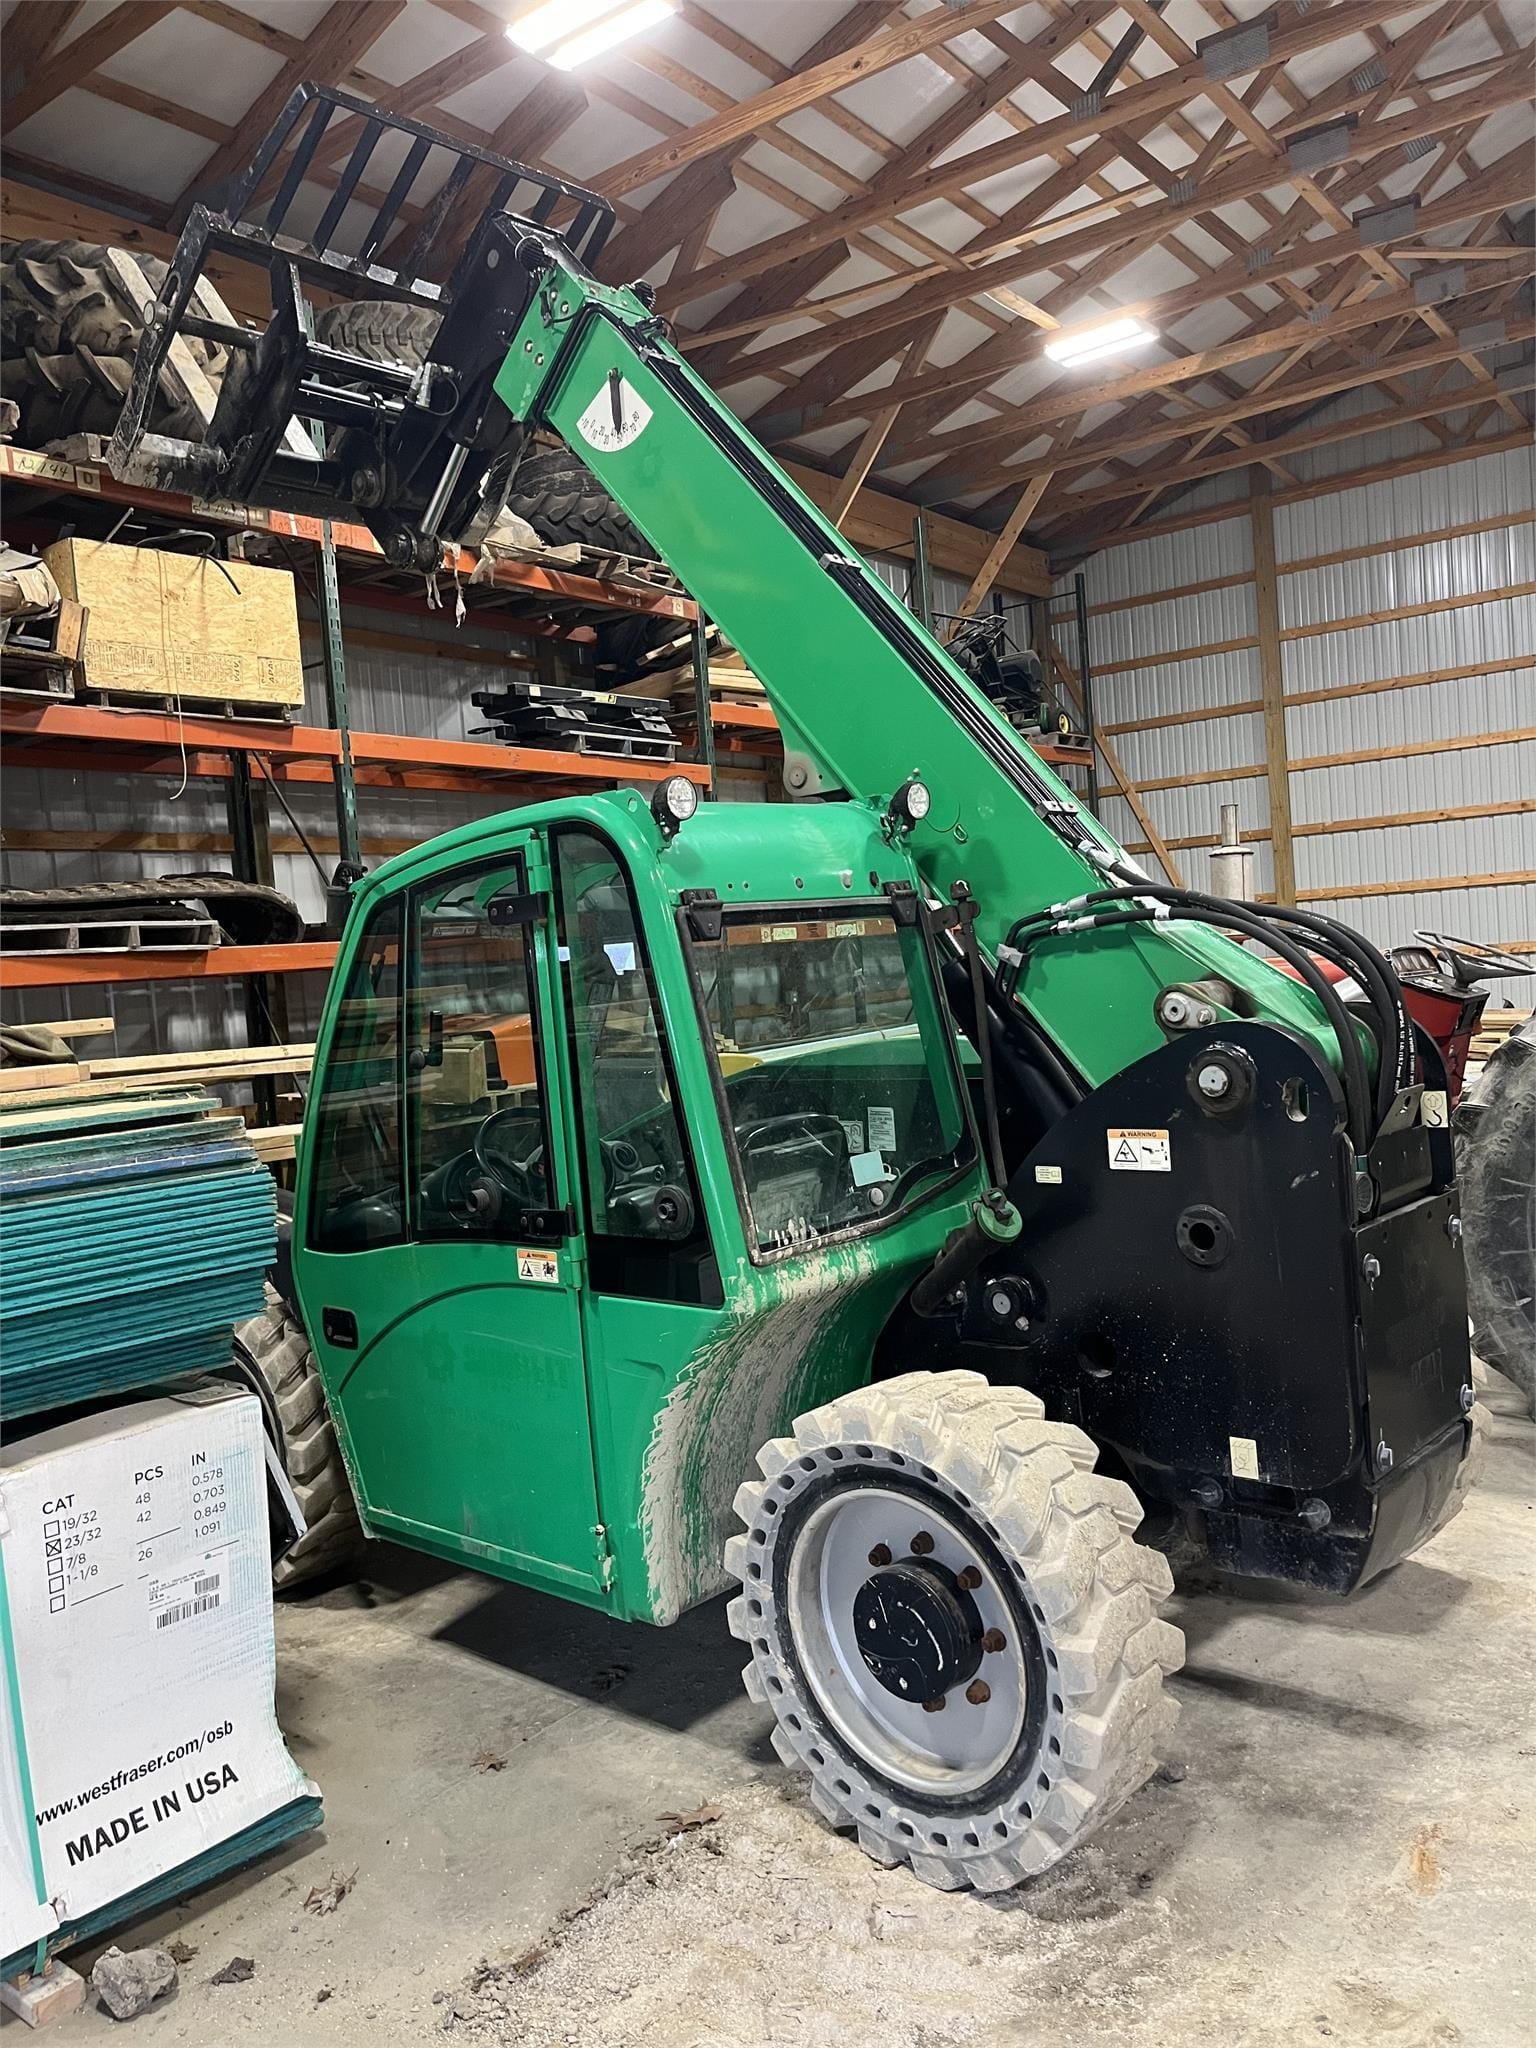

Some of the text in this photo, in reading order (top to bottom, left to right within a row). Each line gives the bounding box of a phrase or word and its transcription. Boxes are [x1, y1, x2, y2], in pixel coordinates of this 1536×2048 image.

[42, 1451, 207, 1515] CAT PCS IN
[63, 1468, 223, 1531] 19/32 48 0.578
[64, 1485, 225, 1550] 23/32 42 0.703
[65, 1502, 227, 1570] 7/8 0.849
[66, 1521, 221, 1585] 1-1/8 26 1.091
[65, 1763, 239, 1867] MADE IN USA
